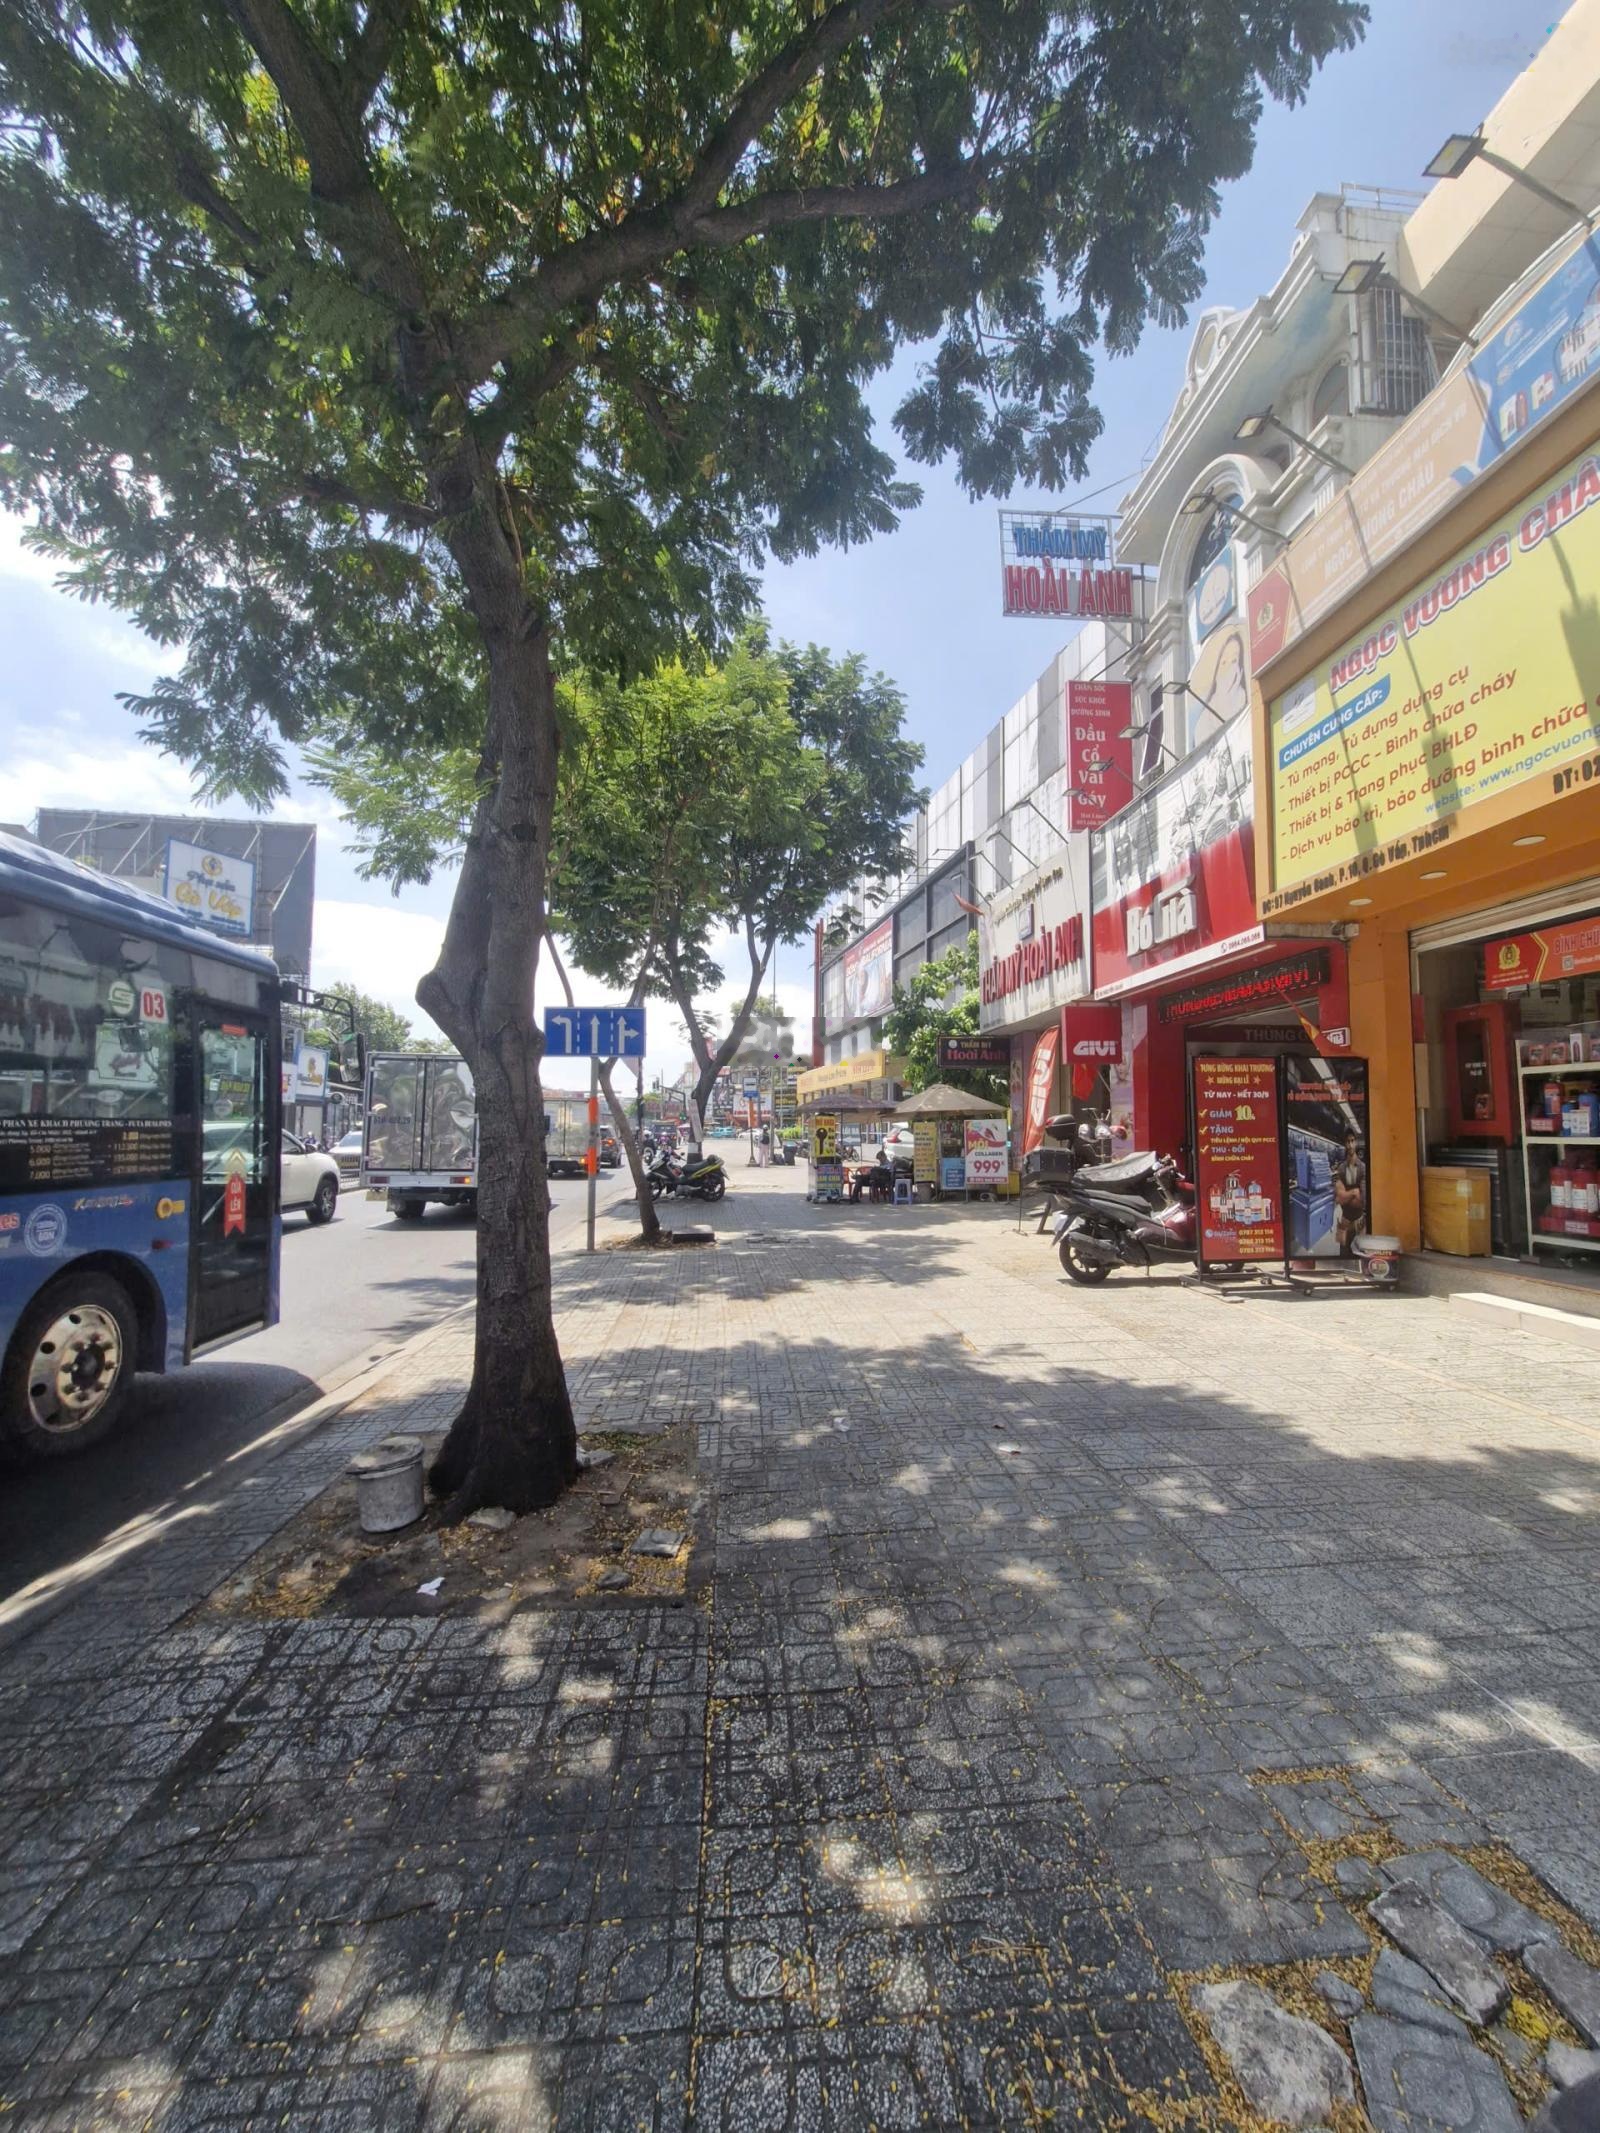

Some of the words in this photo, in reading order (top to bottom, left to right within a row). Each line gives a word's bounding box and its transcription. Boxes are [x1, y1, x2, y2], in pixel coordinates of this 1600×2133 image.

[1005, 557, 1069, 614] HOÀI
[1079, 569, 1132, 616] ANH
[1330, 622, 1399, 695] NGỌC
[1403, 533, 1511, 639] VƯƠNG
[1283, 727, 1321, 762] CHUYÊN
[1322, 708, 1354, 735] CUNG
[1362, 712, 1398, 741] đựng
[1402, 682, 1442, 716] dụng
[1448, 665, 1469, 689] cụ
[1288, 787, 1316, 811] Thiết
[1320, 776, 1330, 793] bị
[1334, 754, 1370, 784] PCCC
[1423, 700, 1464, 732] chữa
[1470, 669, 1517, 705] cháy
[1289, 810, 1317, 835] Thiết
[1320, 802, 1331, 819] bị
[1347, 776, 1385, 800] Trang
[1389, 753, 1427, 784] phục
[1432, 723, 1478, 759] BHLĐ
[1290, 838, 1314, 860] Dịch
[1318, 831, 1332, 845] vụ
[1531, 702, 1588, 739] chữa
[143, 992, 165, 1018] 03
[1073, 1040, 1117, 1057] GIVI
[1237, 1088, 1251, 1098] HẾT
